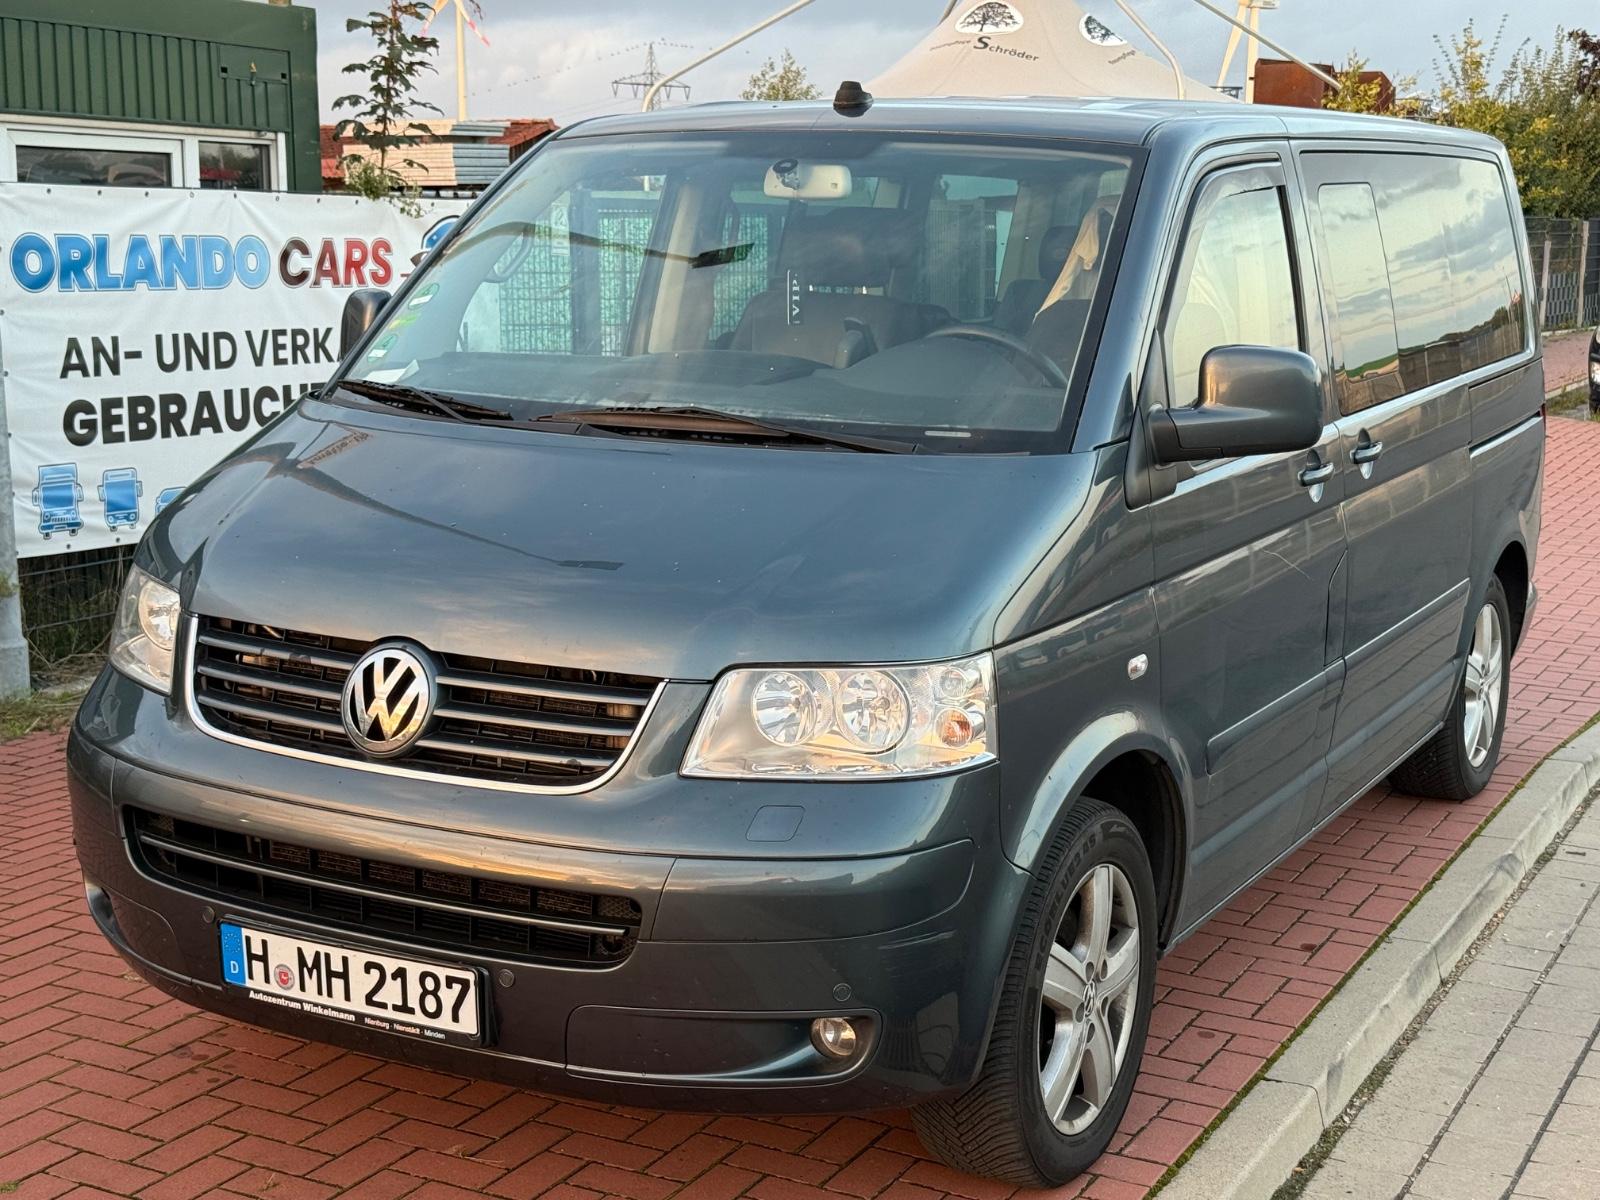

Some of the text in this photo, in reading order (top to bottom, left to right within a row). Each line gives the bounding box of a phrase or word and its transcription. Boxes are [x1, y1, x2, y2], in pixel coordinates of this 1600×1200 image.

[973, 35, 1040, 62] Schröder
[10, 232, 394, 293] ORLANDO CARS
[60, 327, 342, 379] AN- UND VERK
[63, 382, 328, 447] GEBRAUCH
[345, 650, 428, 747] VW
[230, 960, 239, 974] D
[245, 935, 471, 1024] H MH 2187
[249, 990, 301, 1010] Autozentrum
[303, 1002, 355, 1022] Winkelmann
[424, 1029, 445, 1040] Minden
